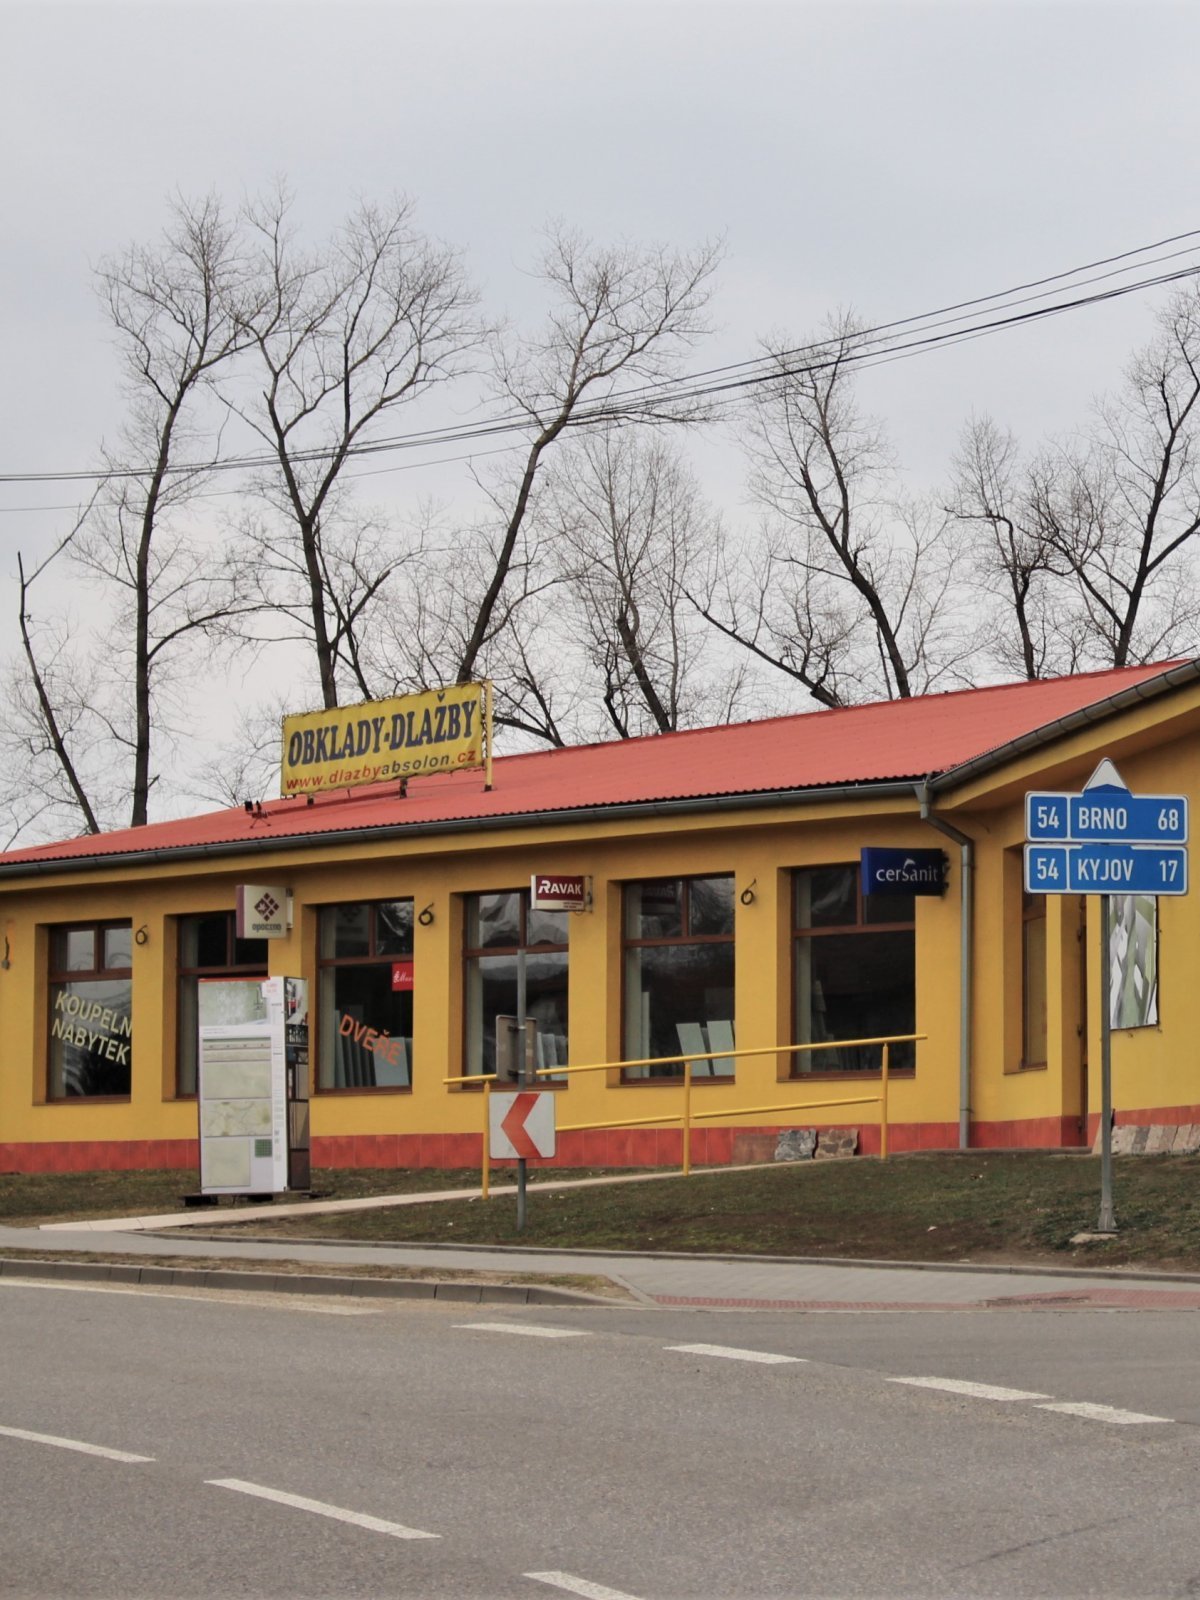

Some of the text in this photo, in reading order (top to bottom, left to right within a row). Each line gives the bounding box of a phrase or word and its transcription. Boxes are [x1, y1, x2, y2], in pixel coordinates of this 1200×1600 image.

[286, 749, 476, 790] www.dlazbyabsolon.cz
[1037, 806, 1179, 831] 54 BRNO 68
[876, 859, 938, 882] cersanit
[1036, 857, 1178, 882] 54 KYJOV 17
[538, 880, 582, 895] RAVAK
[51, 1017, 130, 1066] NÁBYTEK
[338, 1014, 402, 1066] DVEŘE
